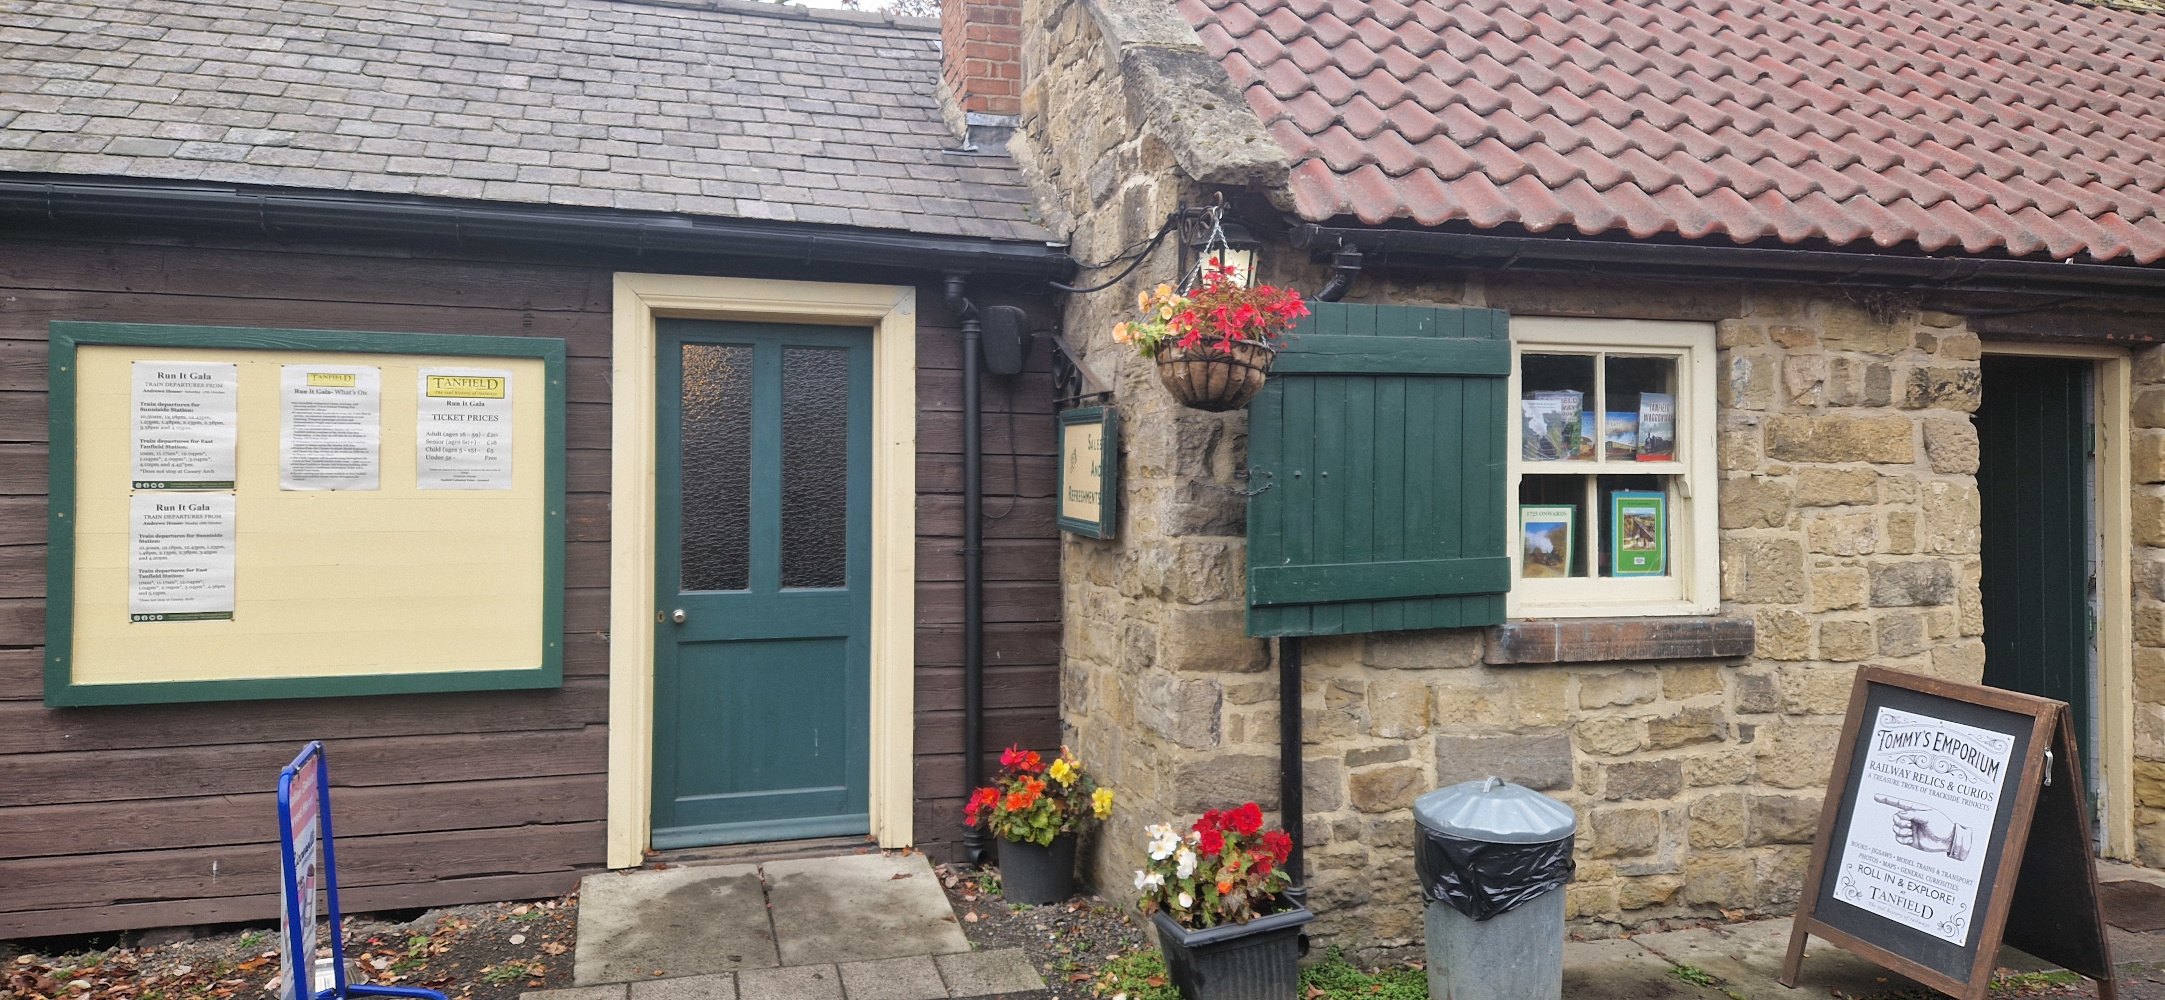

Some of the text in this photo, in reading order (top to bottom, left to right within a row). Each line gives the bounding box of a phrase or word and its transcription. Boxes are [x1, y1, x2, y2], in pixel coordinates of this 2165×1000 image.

[157, 372, 176, 380] Run
[179, 372, 188, 380] It
[311, 374, 352, 382] TANFIELD
[433, 378, 498, 390] TANFIELD
[1650, 403, 1670, 412] TANFIELD
[1088, 434, 1102, 450] SALES
[1091, 460, 1101, 477] AND
[1068, 486, 1101, 506] REFRESHMENTS
[1877, 729, 2000, 784] TOMMY'S EMPORIUM
[1869, 760, 1994, 802] RAILWAY RELICS & CURIOS
[1872, 774, 1900, 786] TREASURE
[1901, 781, 1919, 792] TROVE
[1920, 785, 1928, 793] OF
[1929, 788, 1960, 803] TRACKSIDE
[1961, 797, 1990, 812] TRINKETS
[1851, 840, 1868, 851] BOOKS
[1871, 847, 1892, 860] JIGSAWS
[1896, 855, 1915, 866] MODEL
[1916, 862, 1935, 874] TRAINS
[1941, 870, 1974, 886] TRANSPORT
[1859, 853, 1959, 891] PHOTOS MAPS GENERAL CURIOSITIES
[1858, 864, 1955, 906] ROLL IN & EXPLORE!
[1870, 885, 1934, 920] TANFIELD
[1887, 908, 1902, 919] history
[1910, 917, 1930, 928] railways
